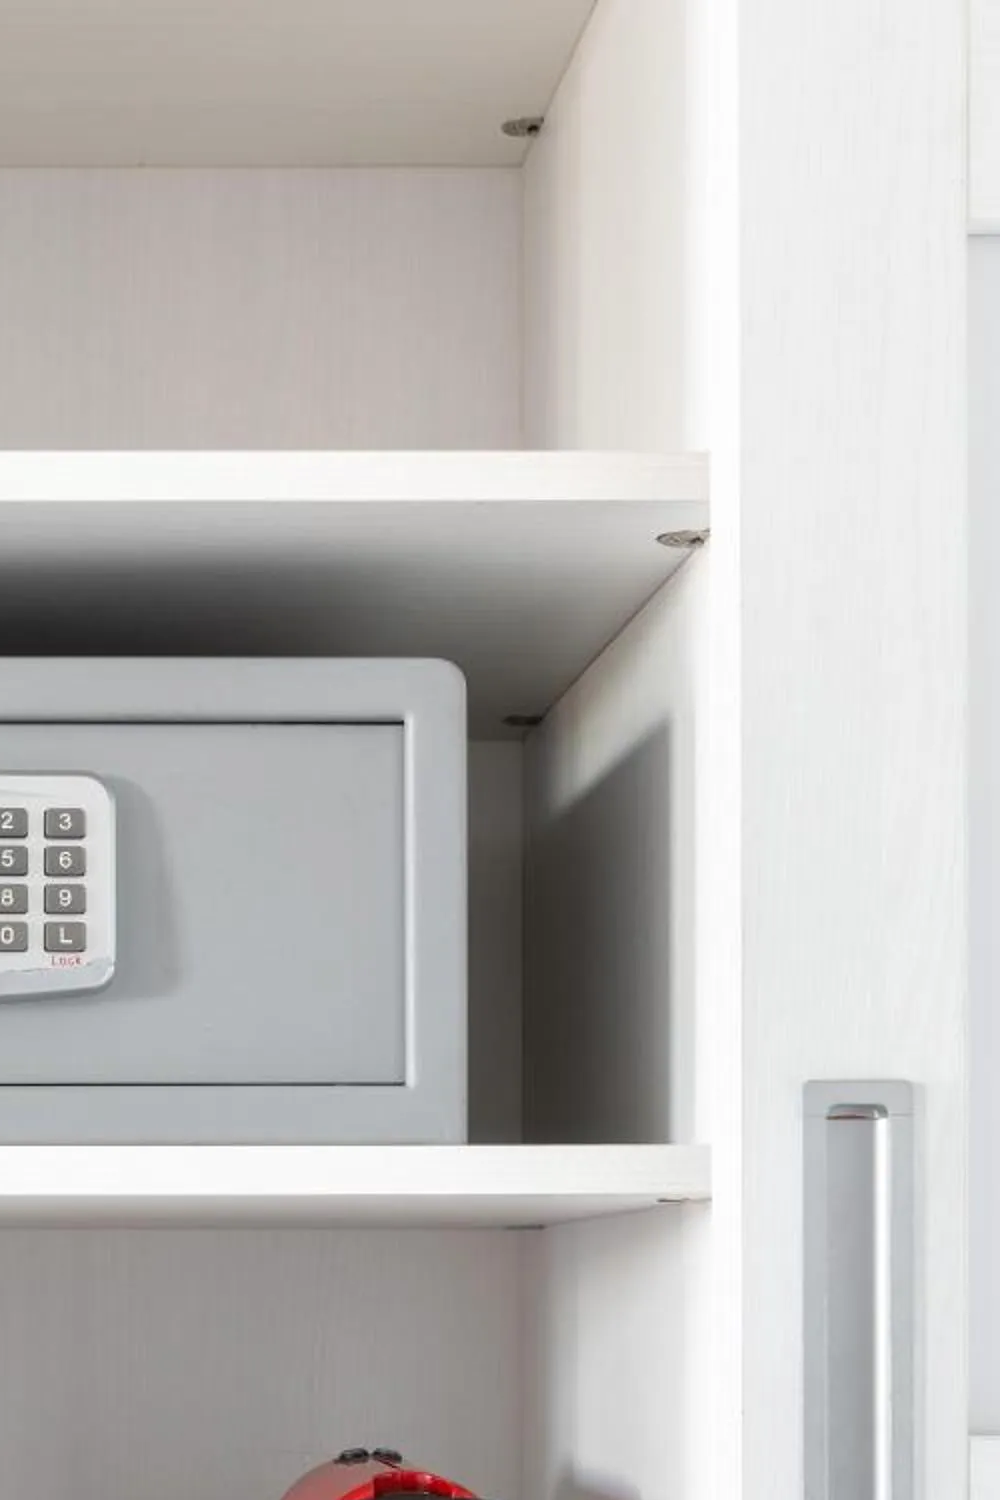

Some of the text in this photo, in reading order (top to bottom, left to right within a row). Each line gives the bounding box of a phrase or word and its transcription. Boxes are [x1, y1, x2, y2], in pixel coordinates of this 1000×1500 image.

[0, 811, 14, 829] 2
[58, 812, 72, 831] 3
[1, 849, 14, 868] 5
[58, 851, 72, 869] 6
[0, 888, 14, 907] 8
[58, 888, 72, 907] 9
[59, 926, 73, 944] L
